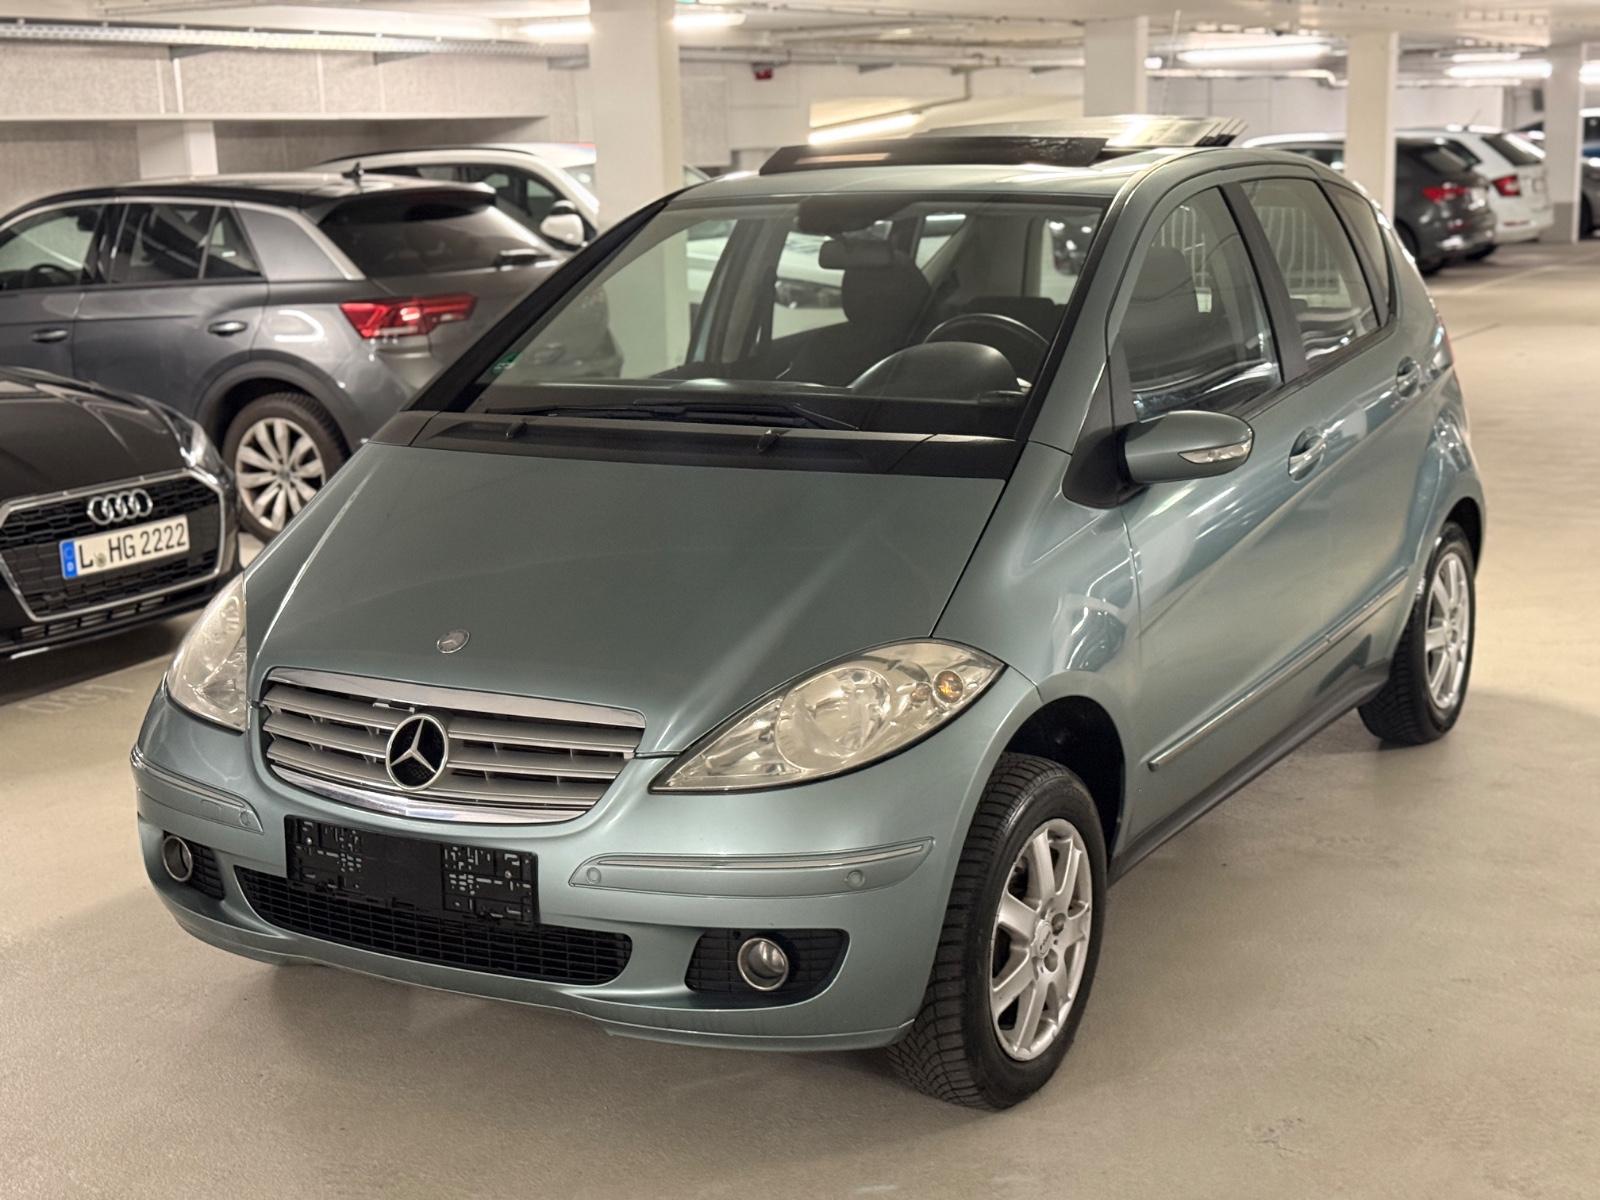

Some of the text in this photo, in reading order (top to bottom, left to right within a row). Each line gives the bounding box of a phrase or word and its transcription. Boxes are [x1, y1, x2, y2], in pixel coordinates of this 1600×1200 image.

[78, 523, 187, 569] L HG 2222
